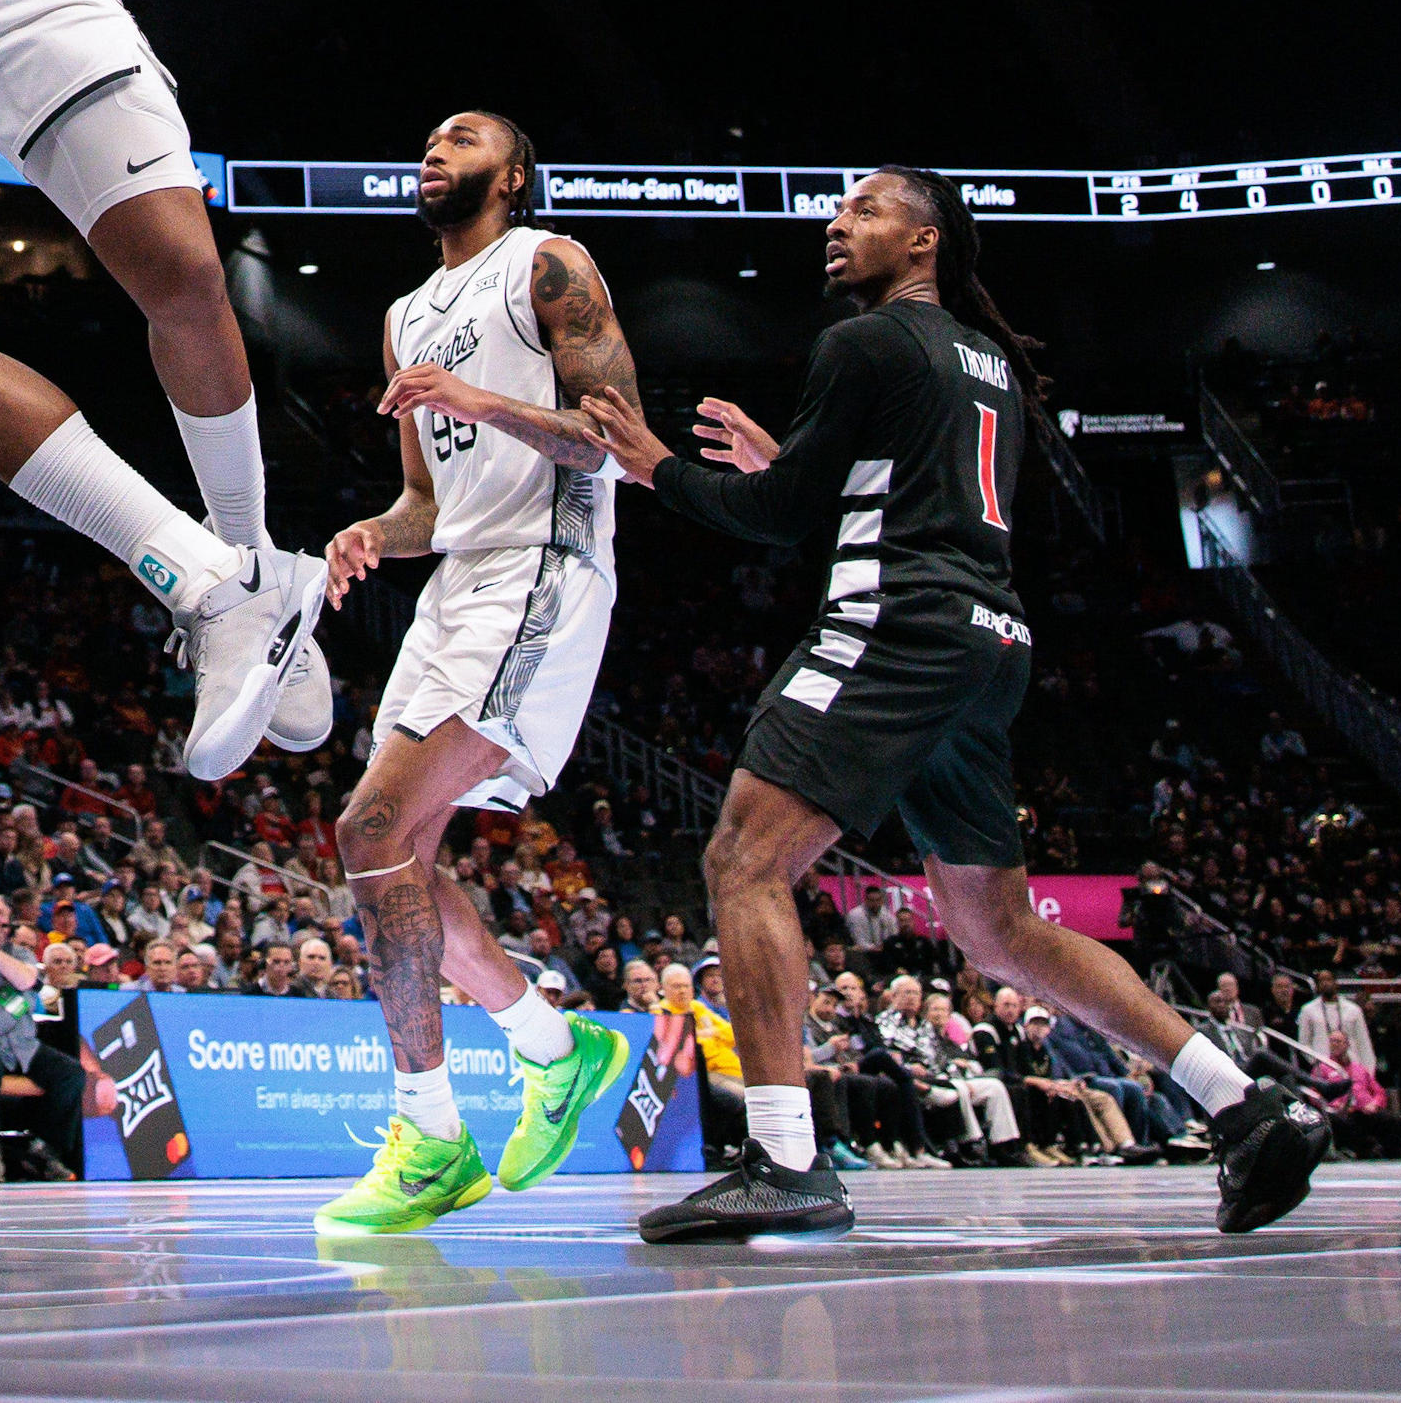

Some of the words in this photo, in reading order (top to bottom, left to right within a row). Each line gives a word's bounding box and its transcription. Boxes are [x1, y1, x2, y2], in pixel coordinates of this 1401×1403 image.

[363, 174, 397, 198] Cal
[549, 177, 682, 200] California-San
[684, 178, 740, 205] Diego
[961, 184, 1016, 206] Fulks
[1120, 194, 1139, 216] 2
[1179, 190, 1198, 212] 4
[1246, 185, 1267, 209] 0
[1310, 181, 1331, 205] 0
[1373, 176, 1393, 200] 0
[953, 342, 1009, 392] THOMAS
[973, 400, 1009, 532] 1
[189, 1028, 265, 1071] Score
[269, 1032, 332, 1073] more
[335, 1033, 388, 1074] with
[256, 1085, 288, 1110] Earn
